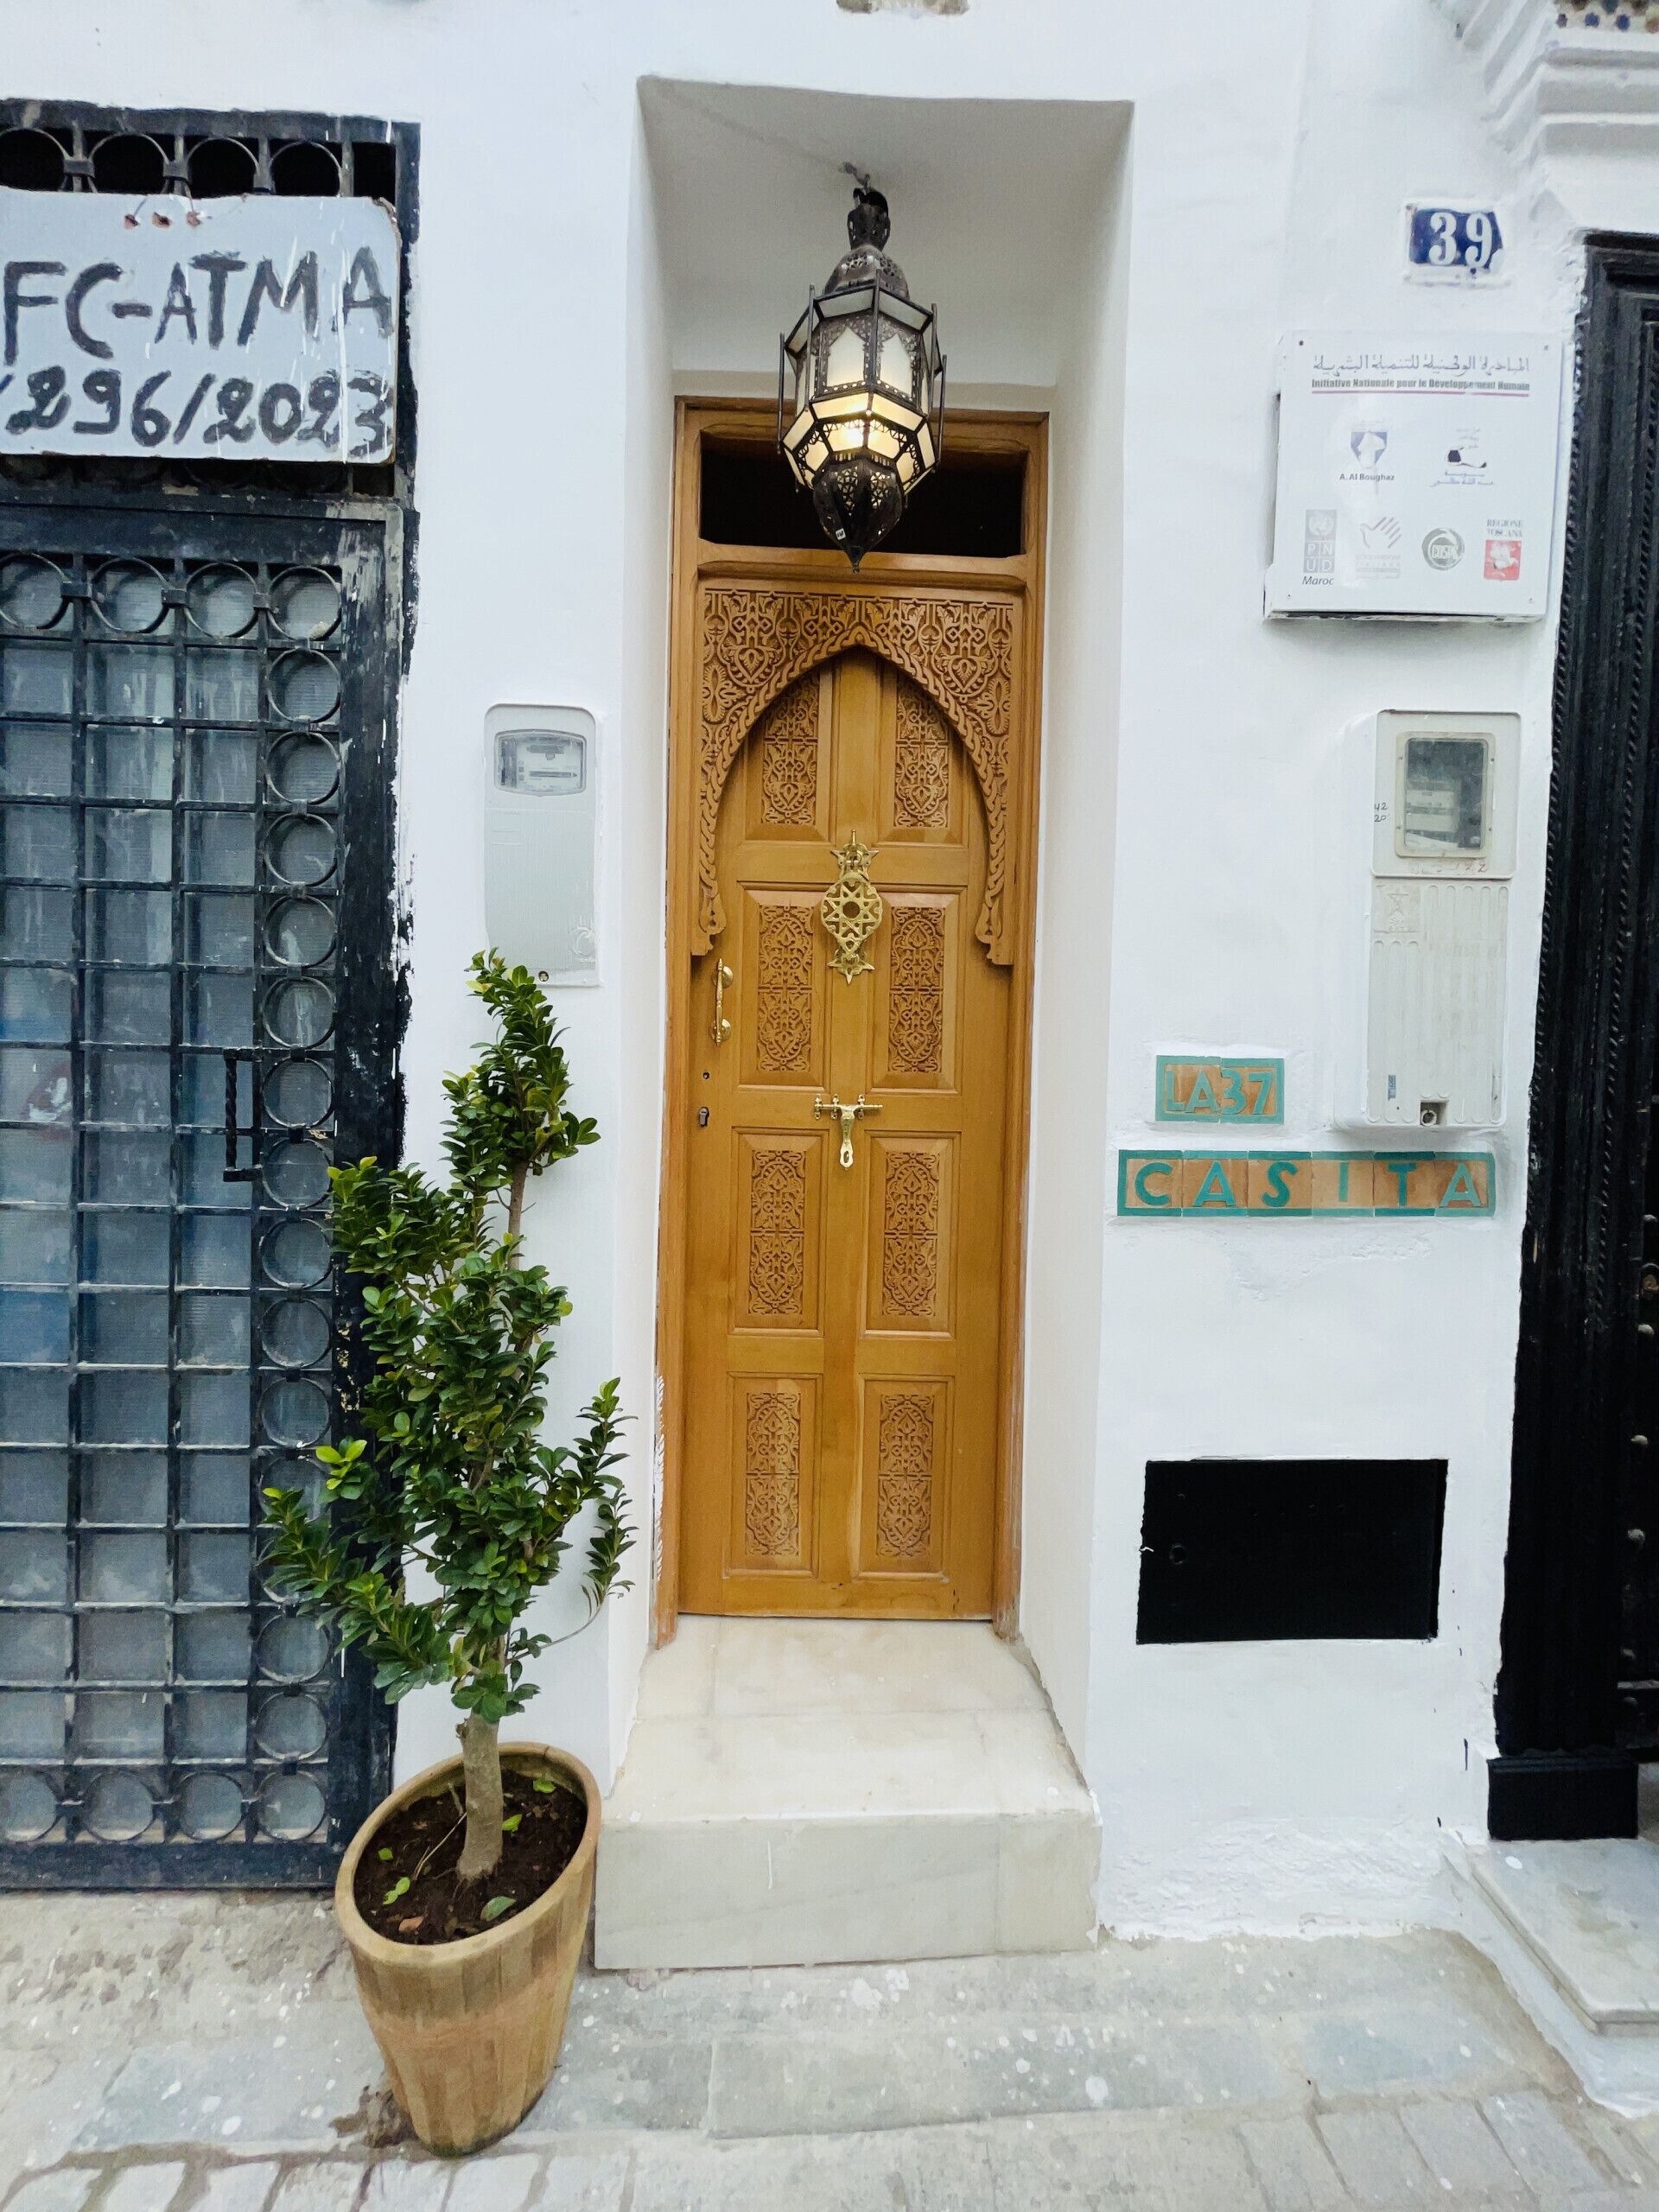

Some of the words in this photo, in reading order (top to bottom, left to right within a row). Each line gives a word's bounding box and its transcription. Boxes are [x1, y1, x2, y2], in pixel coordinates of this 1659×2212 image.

[1428, 212, 1492, 266] 39
[1313, 354, 1369, 377] البشرية
[1371, 354, 1420, 374] للتنمية
[1312, 378, 1351, 388] Initiative
[1353, 378, 1395, 388] Nationale
[1396, 379, 1417, 389] pour
[1419, 378, 1427, 388] le
[1497, 381, 1530, 391] Humain
[0, 365, 394, 457] 296/2023
[1302, 576, 1334, 585] Maroc
[1219, 1067, 1274, 1115] 37
[1135, 1160, 1481, 1207] CASITA
